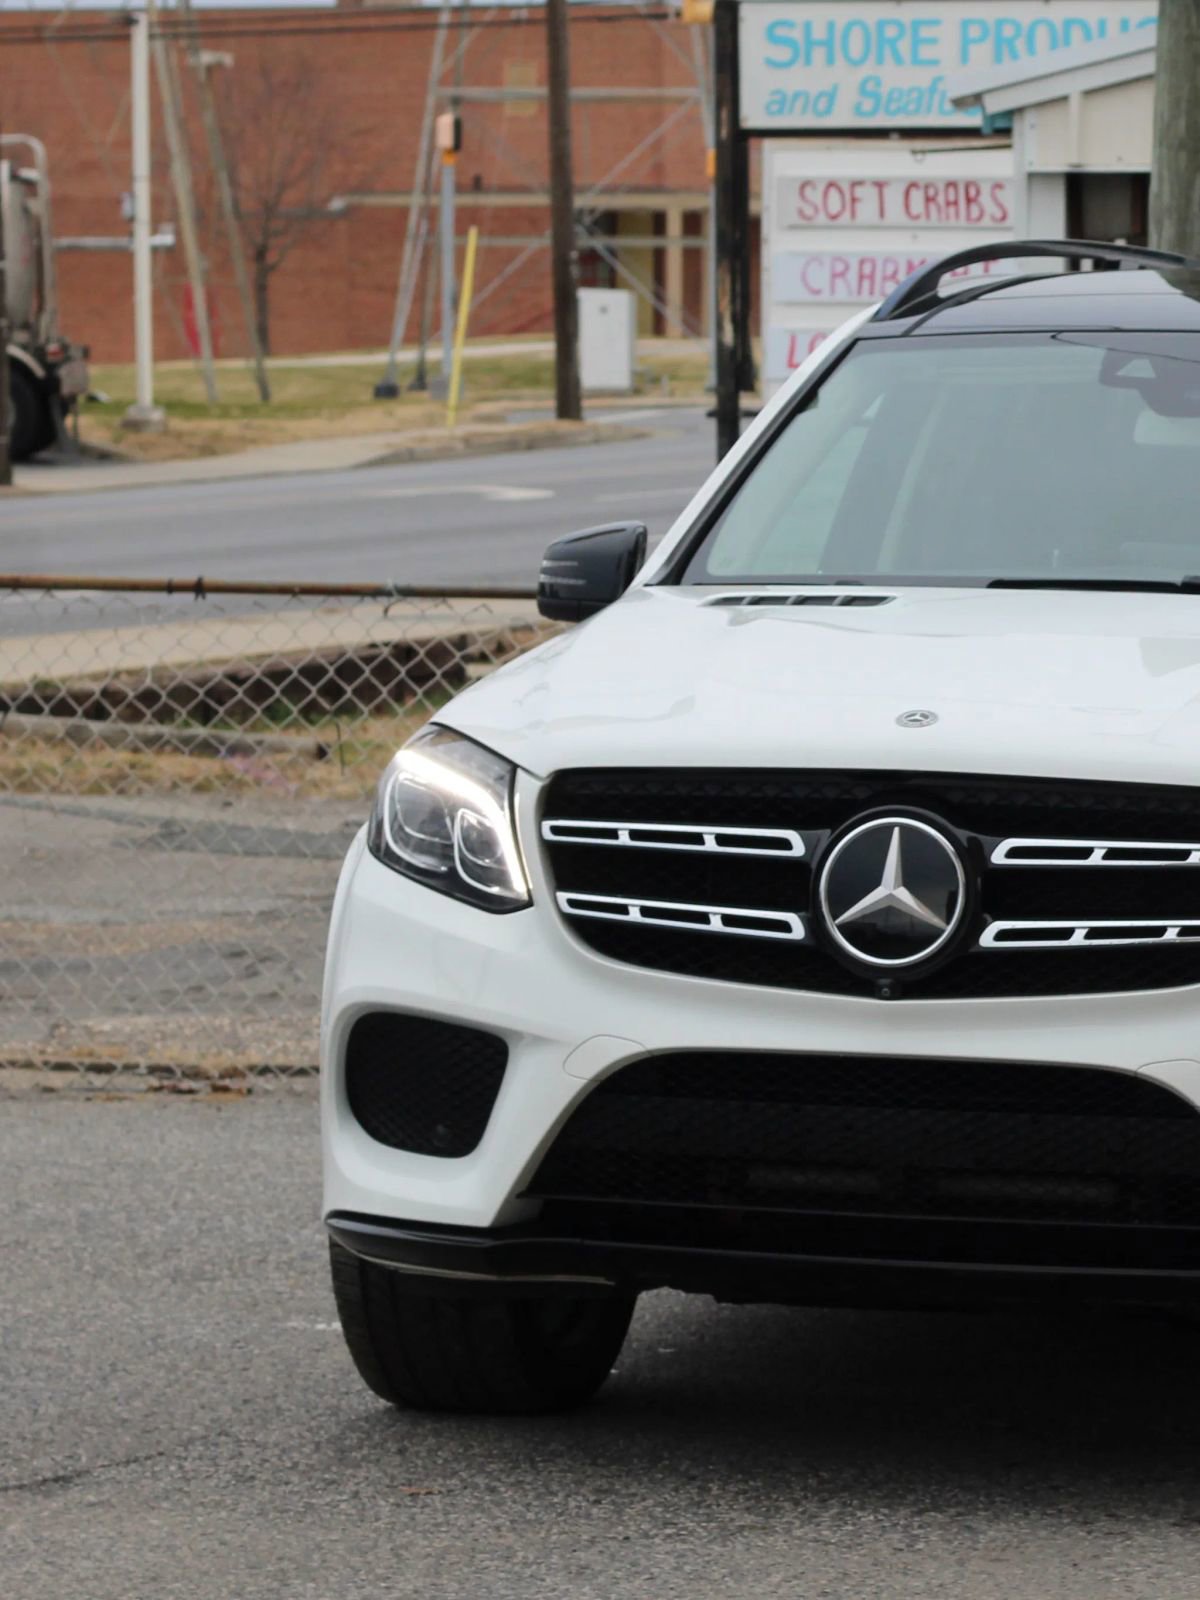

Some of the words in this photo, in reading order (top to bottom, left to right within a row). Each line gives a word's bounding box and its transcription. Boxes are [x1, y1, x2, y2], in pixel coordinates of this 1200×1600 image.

[763, 17, 943, 70] SHORE
[764, 83, 840, 118] and
[798, 179, 891, 222] SOFT
[902, 178, 1009, 225] CRABS
